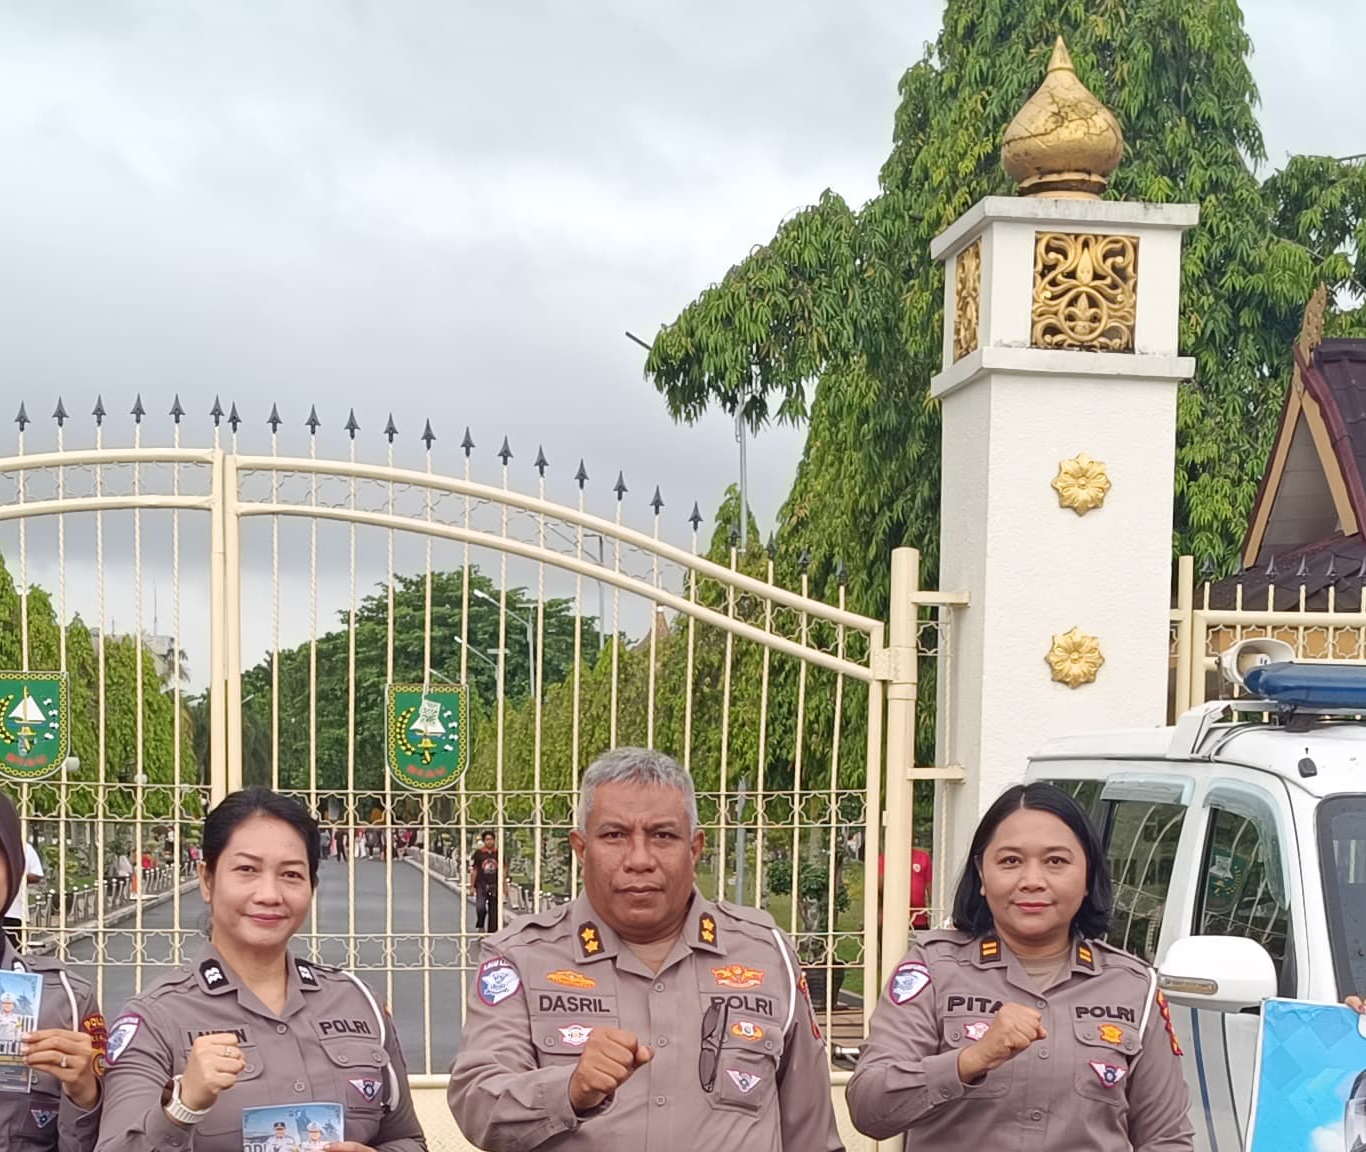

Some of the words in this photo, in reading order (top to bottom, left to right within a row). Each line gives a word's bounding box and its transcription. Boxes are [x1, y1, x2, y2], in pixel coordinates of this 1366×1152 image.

[539, 995, 611, 1013] DASRIL
[710, 996, 773, 1017] POLRI
[947, 995, 1004, 1013] PITA
[1075, 1006, 1136, 1023] POLRI
[319, 1019, 372, 1036] POLRI
